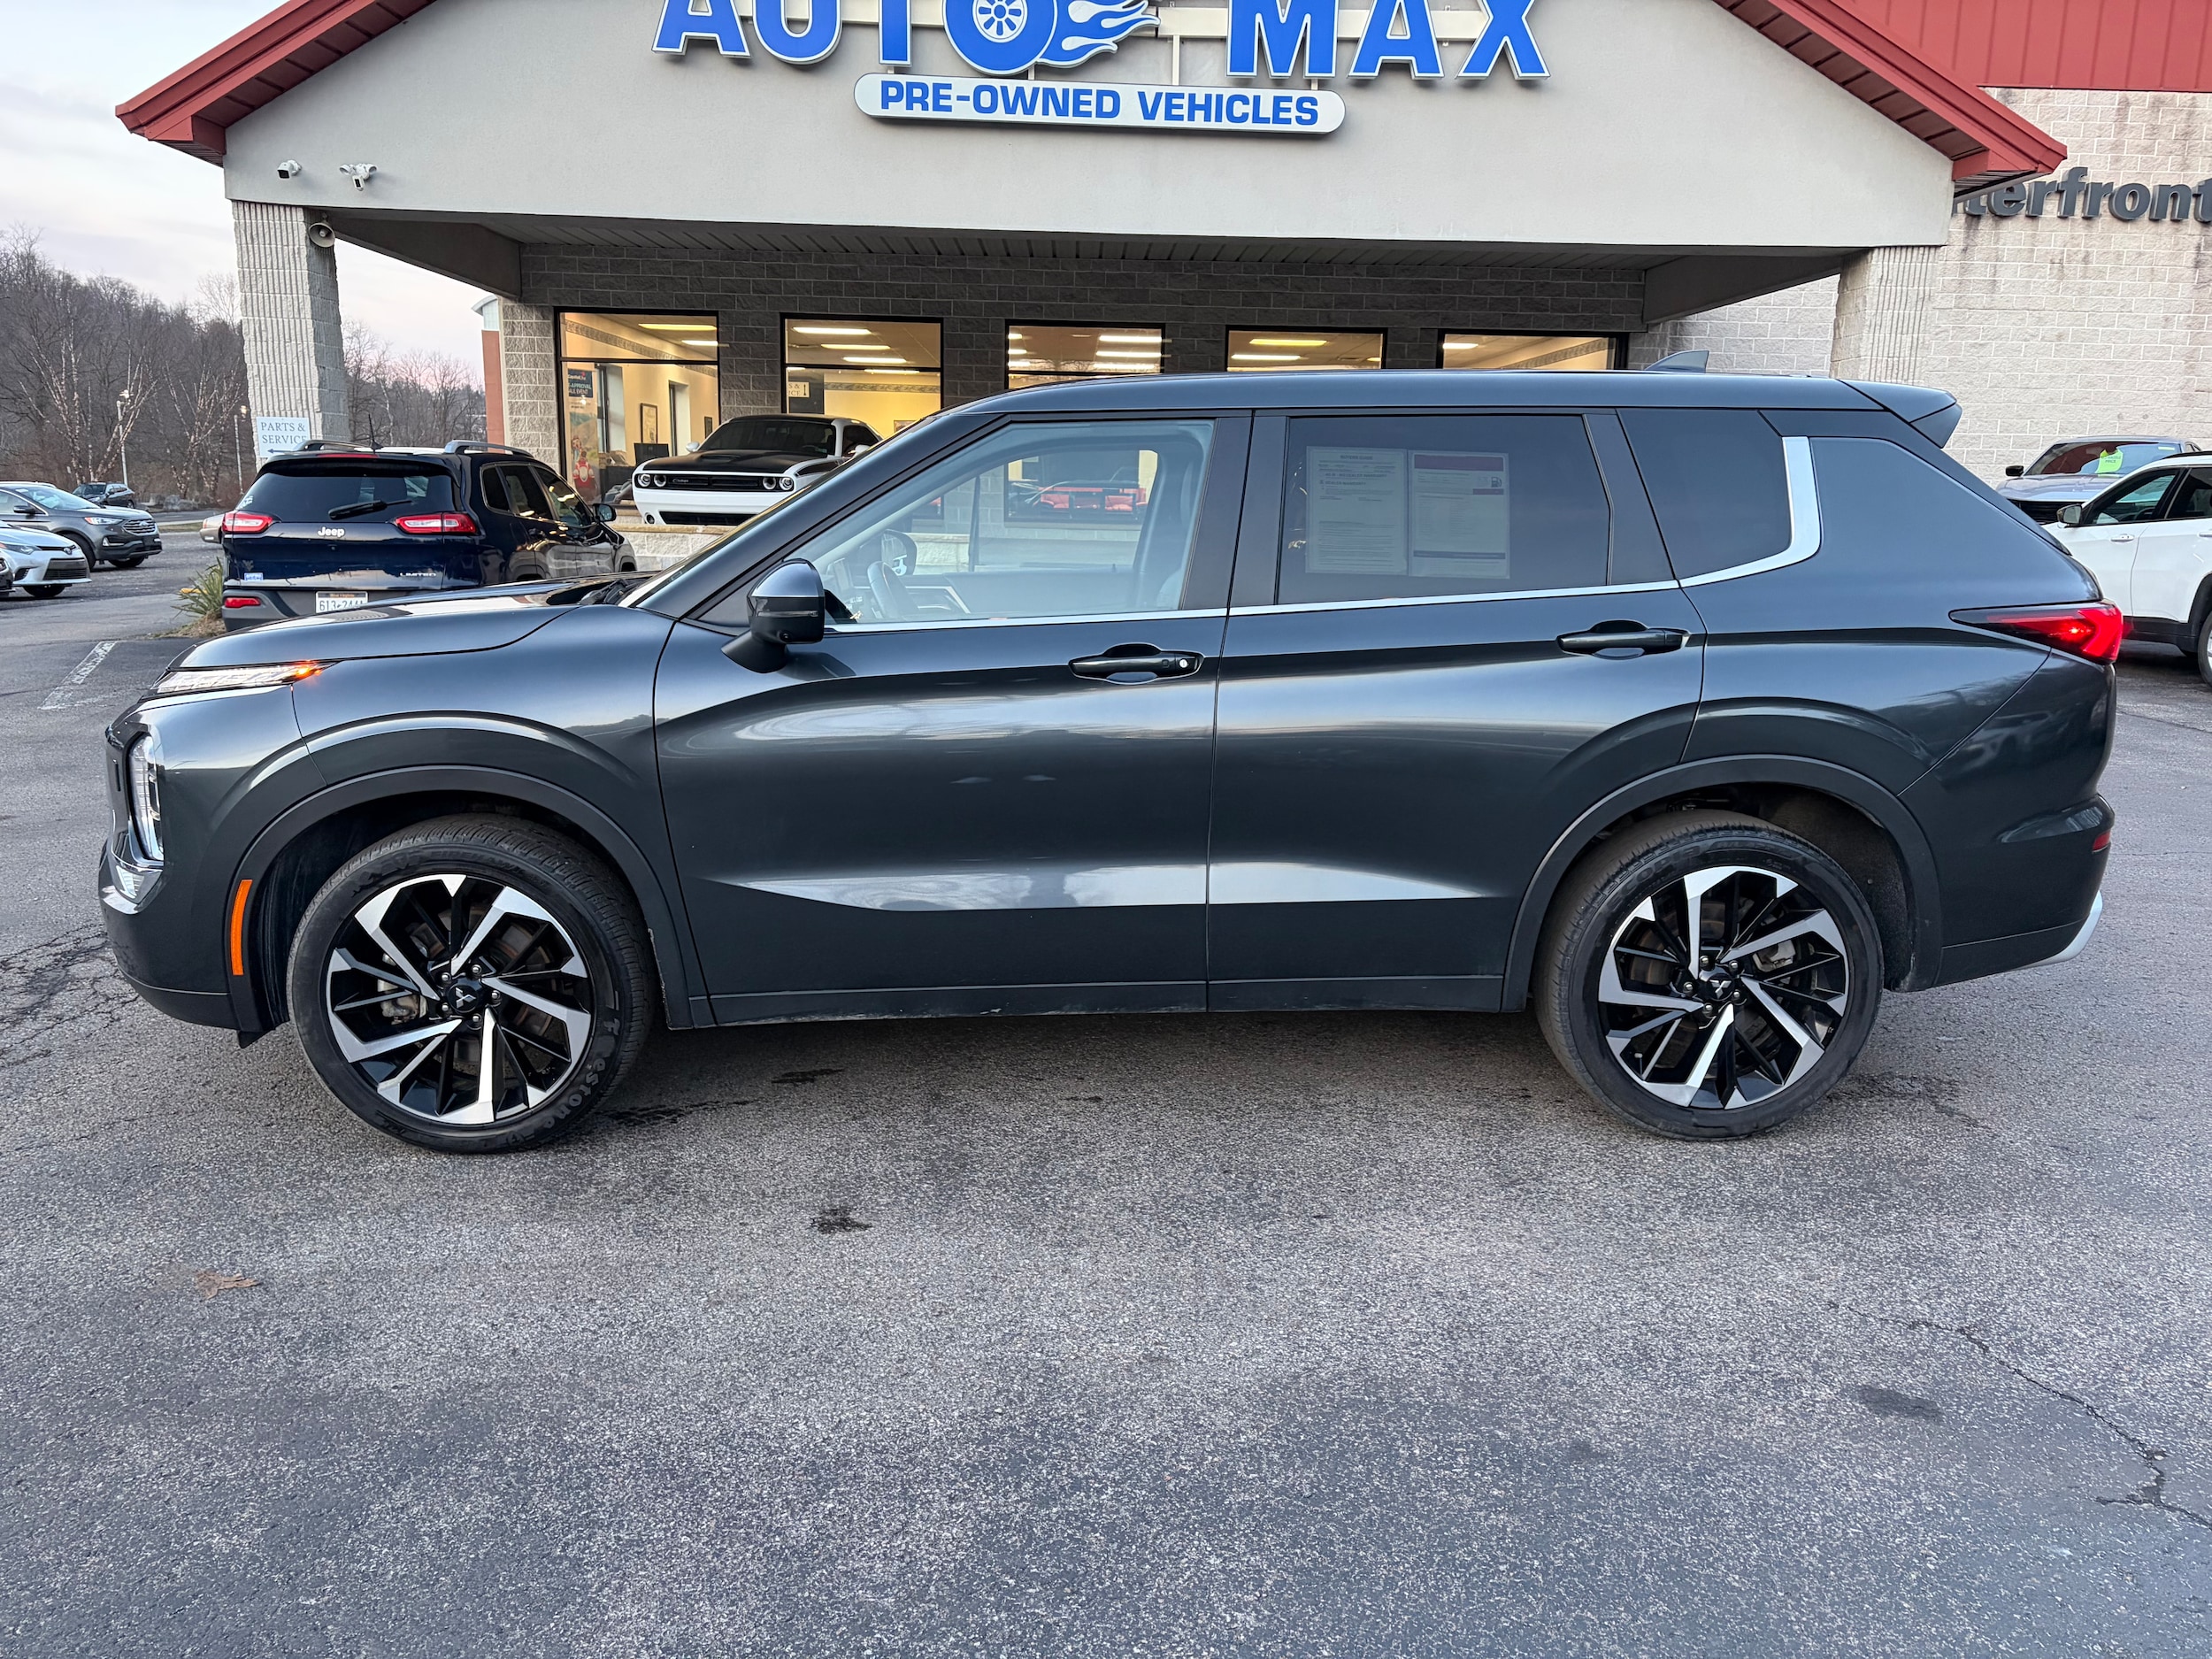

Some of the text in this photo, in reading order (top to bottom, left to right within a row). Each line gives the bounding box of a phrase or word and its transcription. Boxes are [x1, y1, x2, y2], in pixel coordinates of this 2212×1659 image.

[1225, 0, 1550, 80] MAX
[879, 81, 1319, 126] PRE-OWNED VEHICLES
[261, 421, 305, 432] PARTS &
[262, 434, 307, 444] SERVICE
[318, 526, 345, 538] Jeep
